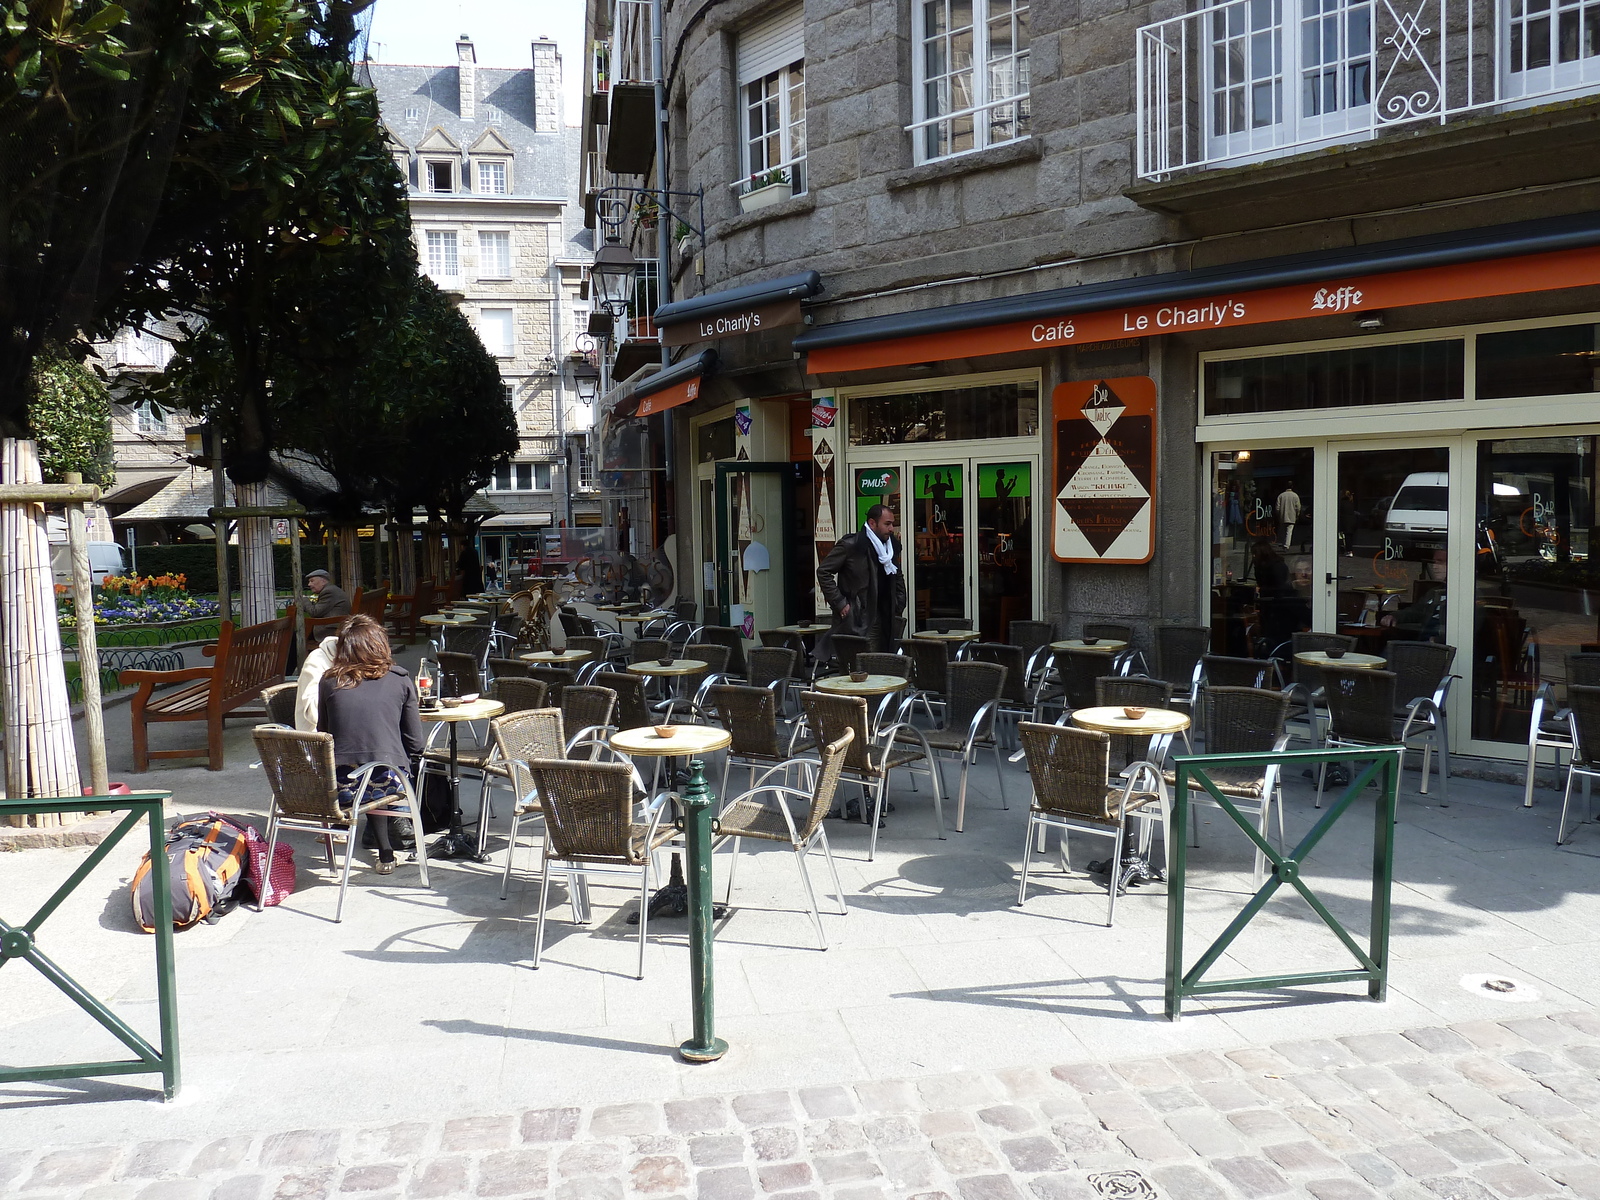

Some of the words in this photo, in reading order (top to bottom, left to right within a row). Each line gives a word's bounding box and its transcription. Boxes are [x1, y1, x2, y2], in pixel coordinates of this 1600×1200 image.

[1310, 286, 1364, 312] Leffe
[700, 322, 714, 338] Le
[716, 312, 761, 335] Charly's
[1123, 313, 1149, 332] Le
[1156, 300, 1246, 329] Charly's
[1031, 321, 1076, 343] Café
[861, 478, 881, 488] PMU
